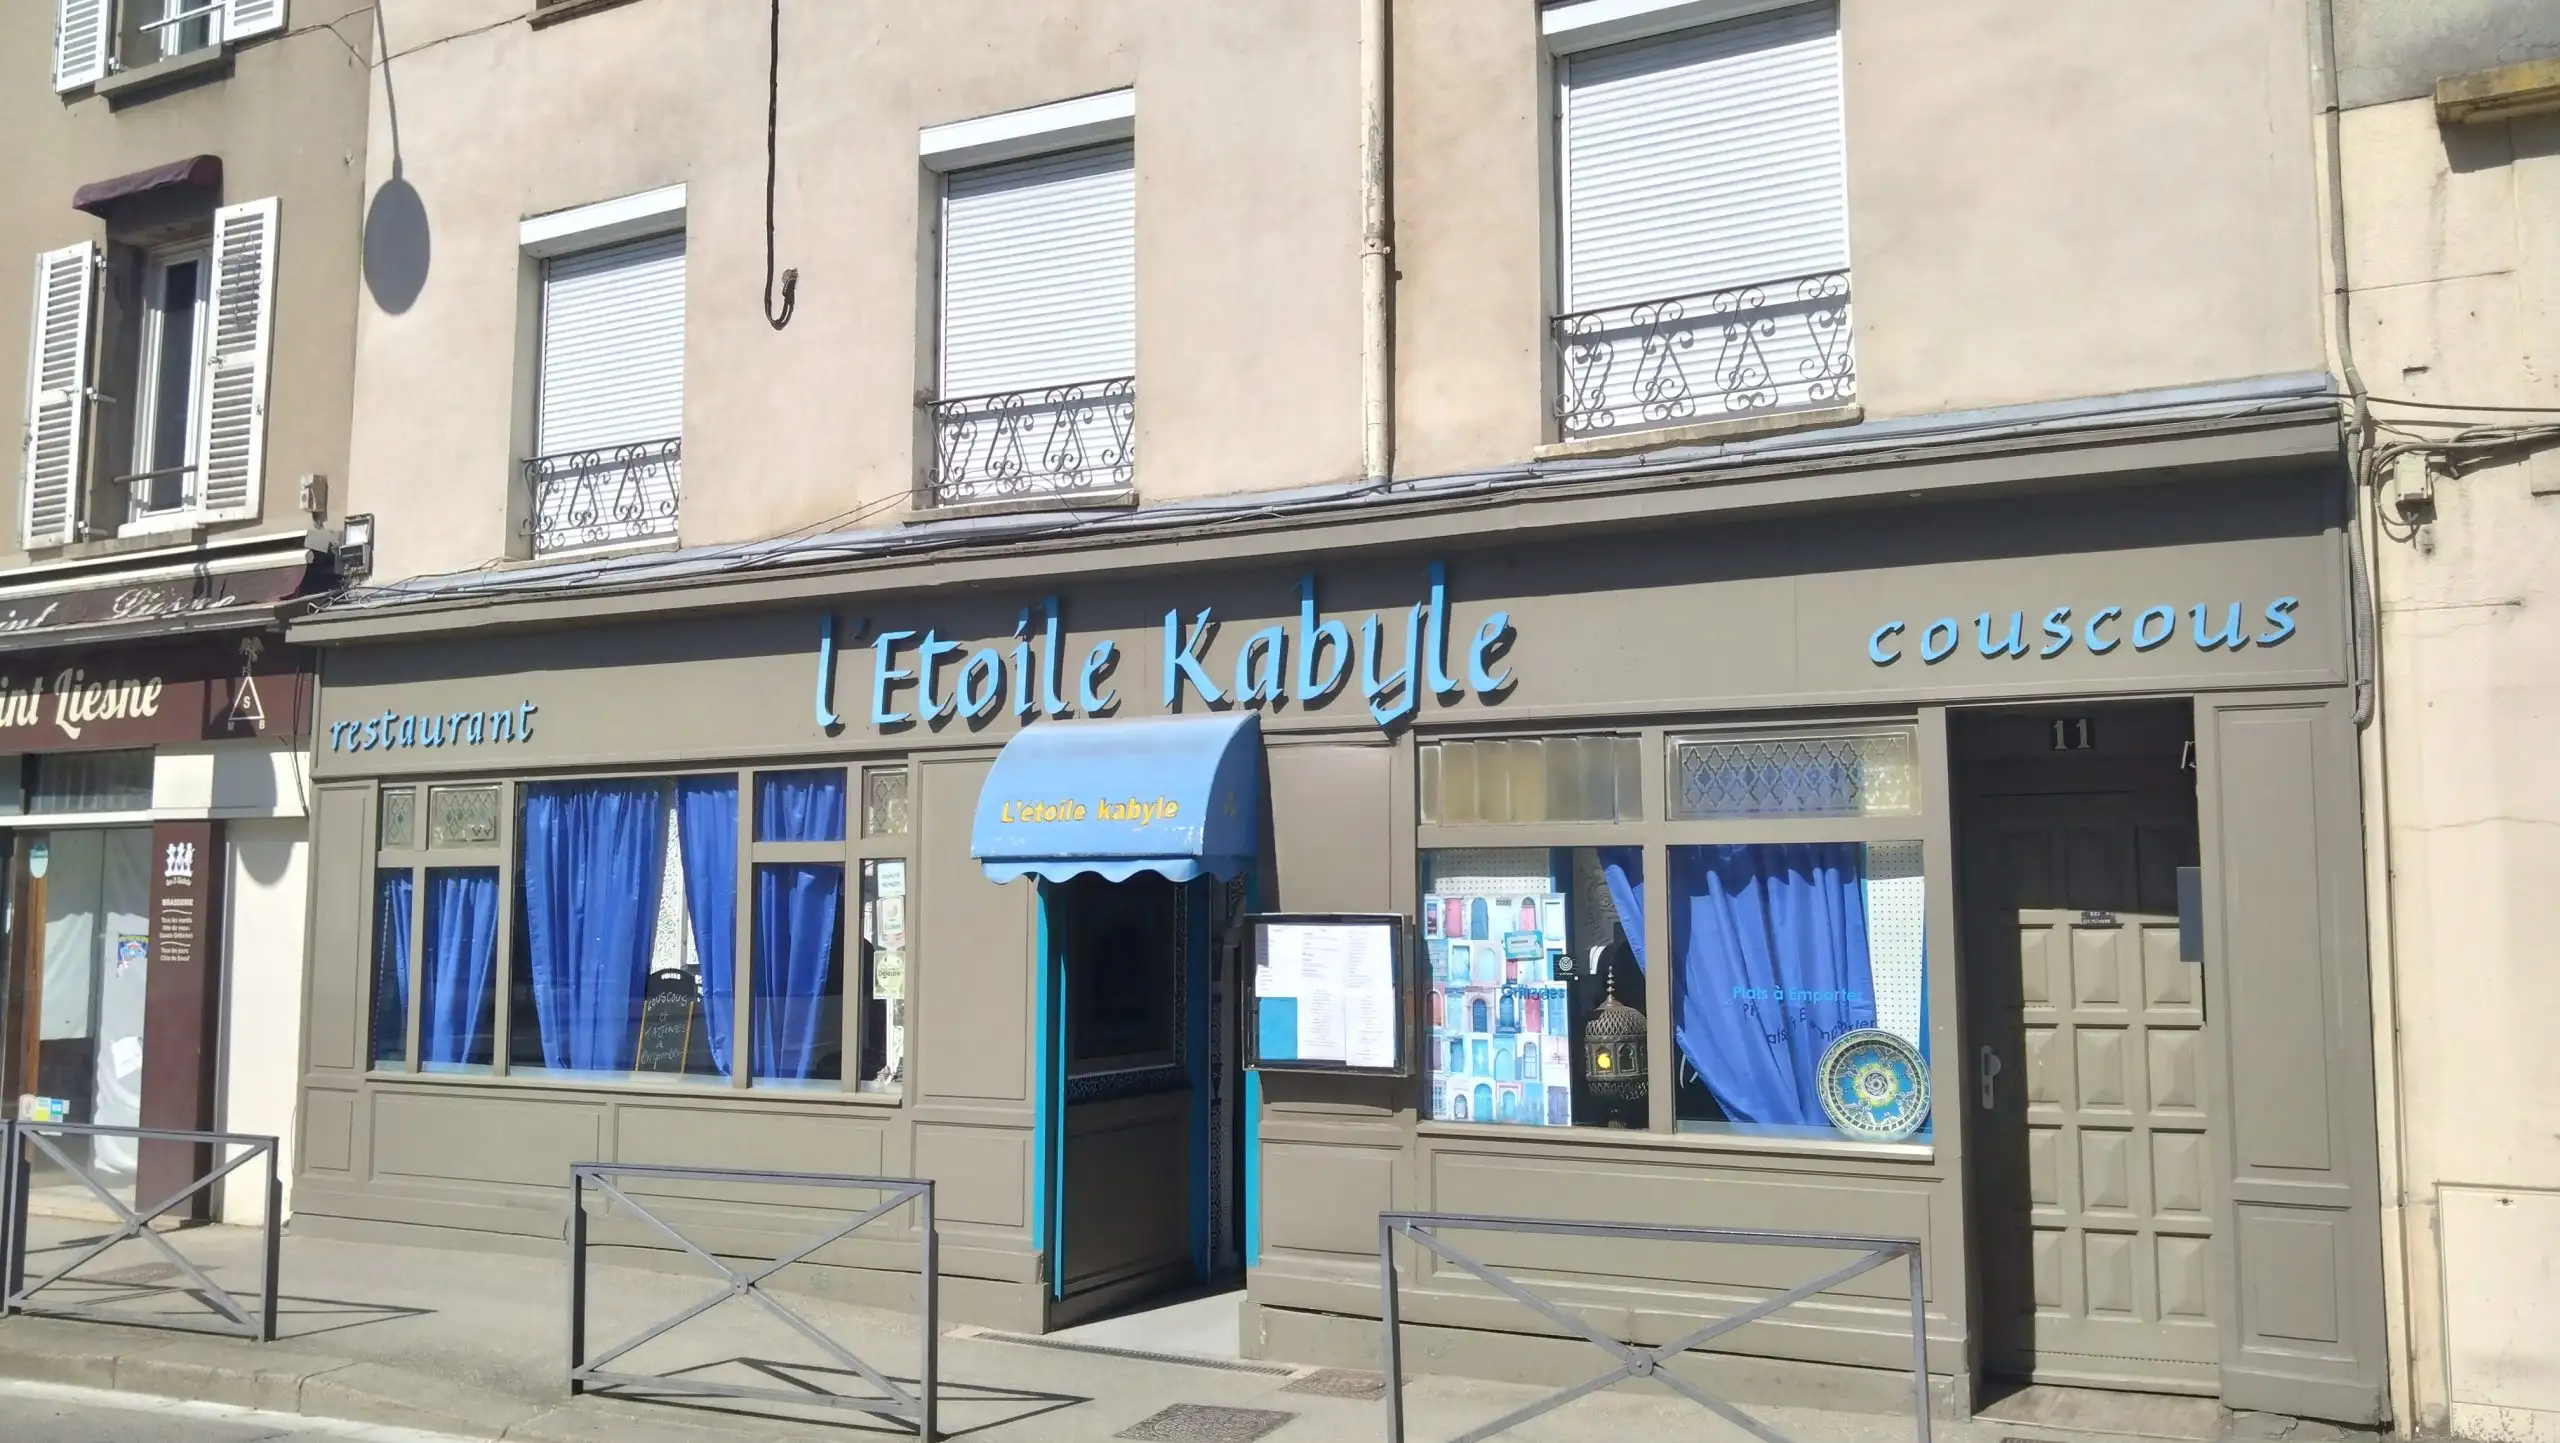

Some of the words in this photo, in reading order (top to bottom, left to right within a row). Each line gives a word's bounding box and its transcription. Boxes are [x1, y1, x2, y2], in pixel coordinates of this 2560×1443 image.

[1164, 562, 1513, 728] Kabyle
[1868, 597, 2299, 665] couscous
[54, 668, 163, 740] Liesne
[243, 696, 251, 709] S
[330, 700, 538, 753] restaurant
[2053, 718, 2092, 750] 11
[1097, 796, 1179, 826] kabyle
[1732, 985, 1768, 1000] Plats
[1773, 984, 1784, 1001] à
[1789, 988, 1864, 1003] Emporter
